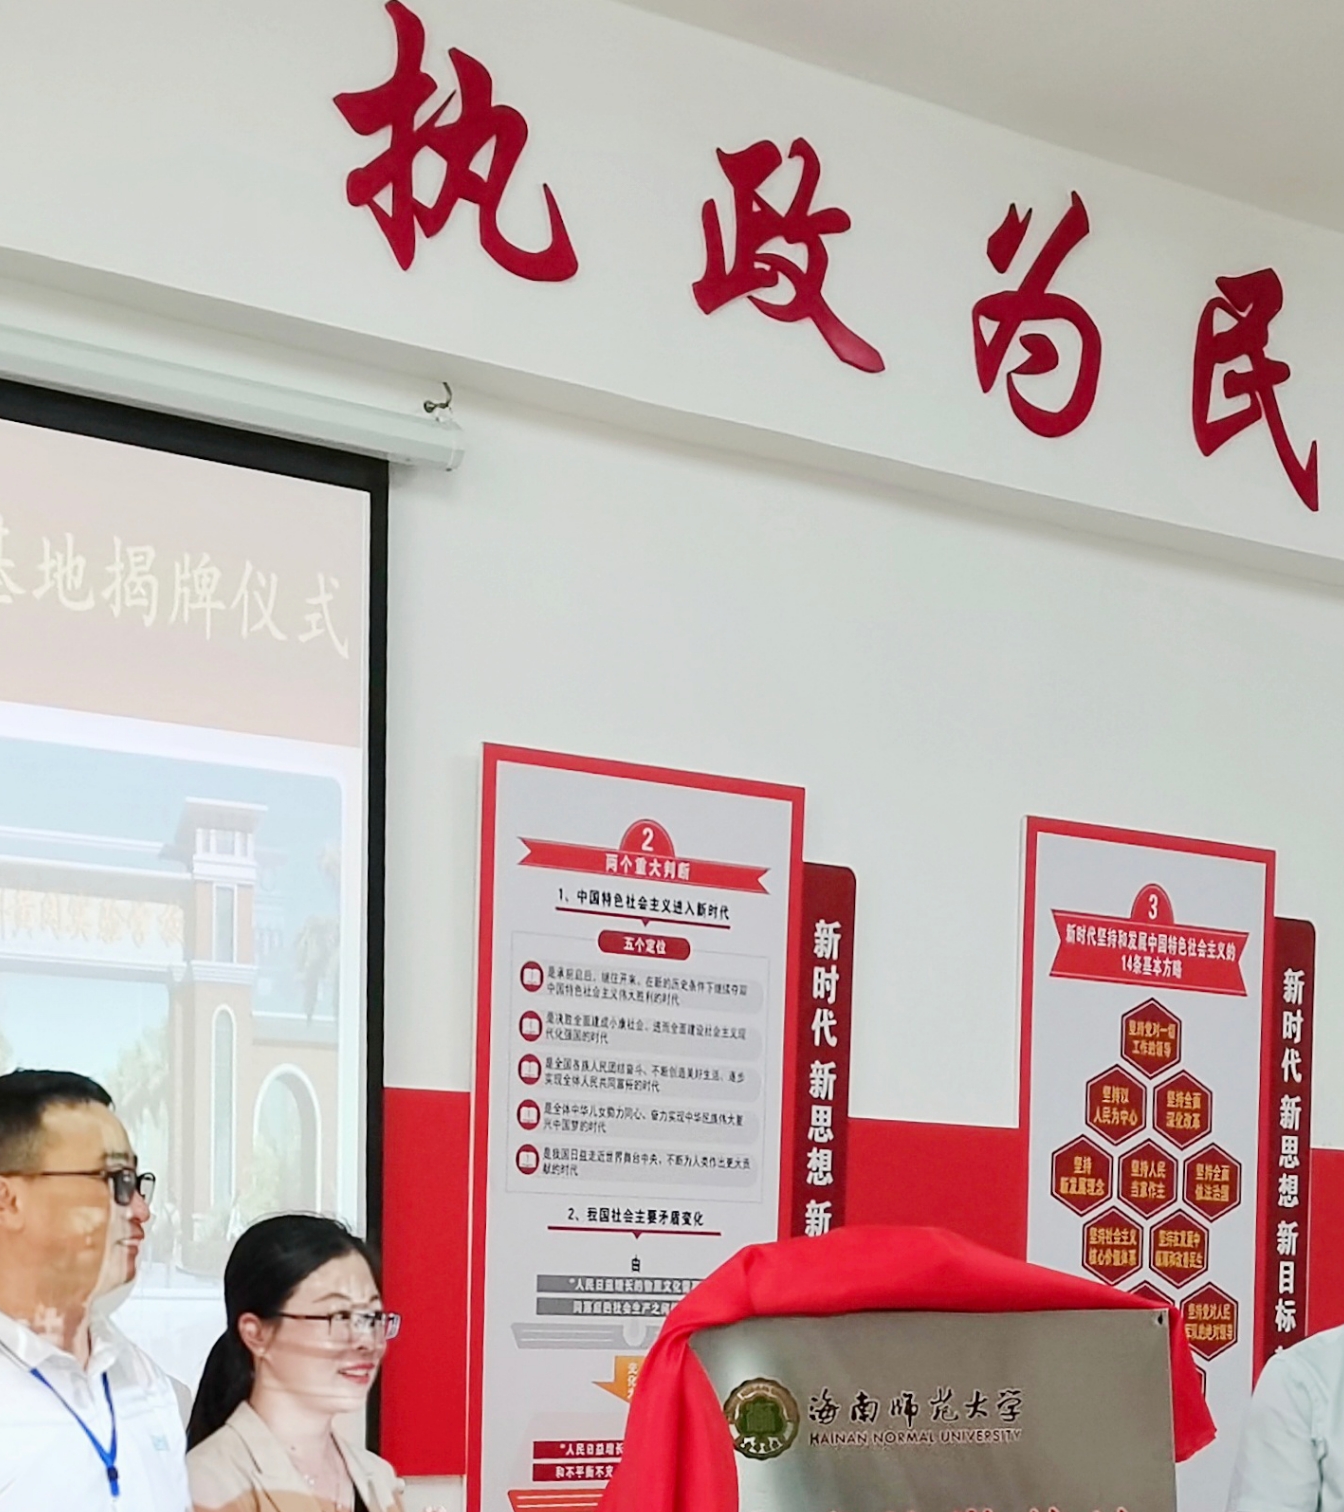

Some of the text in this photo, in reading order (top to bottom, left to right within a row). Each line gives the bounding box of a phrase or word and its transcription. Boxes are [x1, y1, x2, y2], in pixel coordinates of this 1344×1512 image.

[332, 0, 1320, 512] 执政为民
[605, 853, 691, 881] 两个重大判断
[641, 827, 654, 852] 2
[623, 936, 667, 955] 五个定位
[1148, 893, 1159, 920] 3
[811, 919, 842, 1047] 新时代
[1281, 967, 1306, 1083] 新时代
[806, 1060, 837, 1187] 新思想
[1277, 1094, 1302, 1209] 新思想
[1274, 1220, 1300, 1334] 新目标
[808, 1386, 1023, 1429] 海南师范大学
[809, 1428, 1022, 1447] HAINAN NORMAL UNIVERSITY
